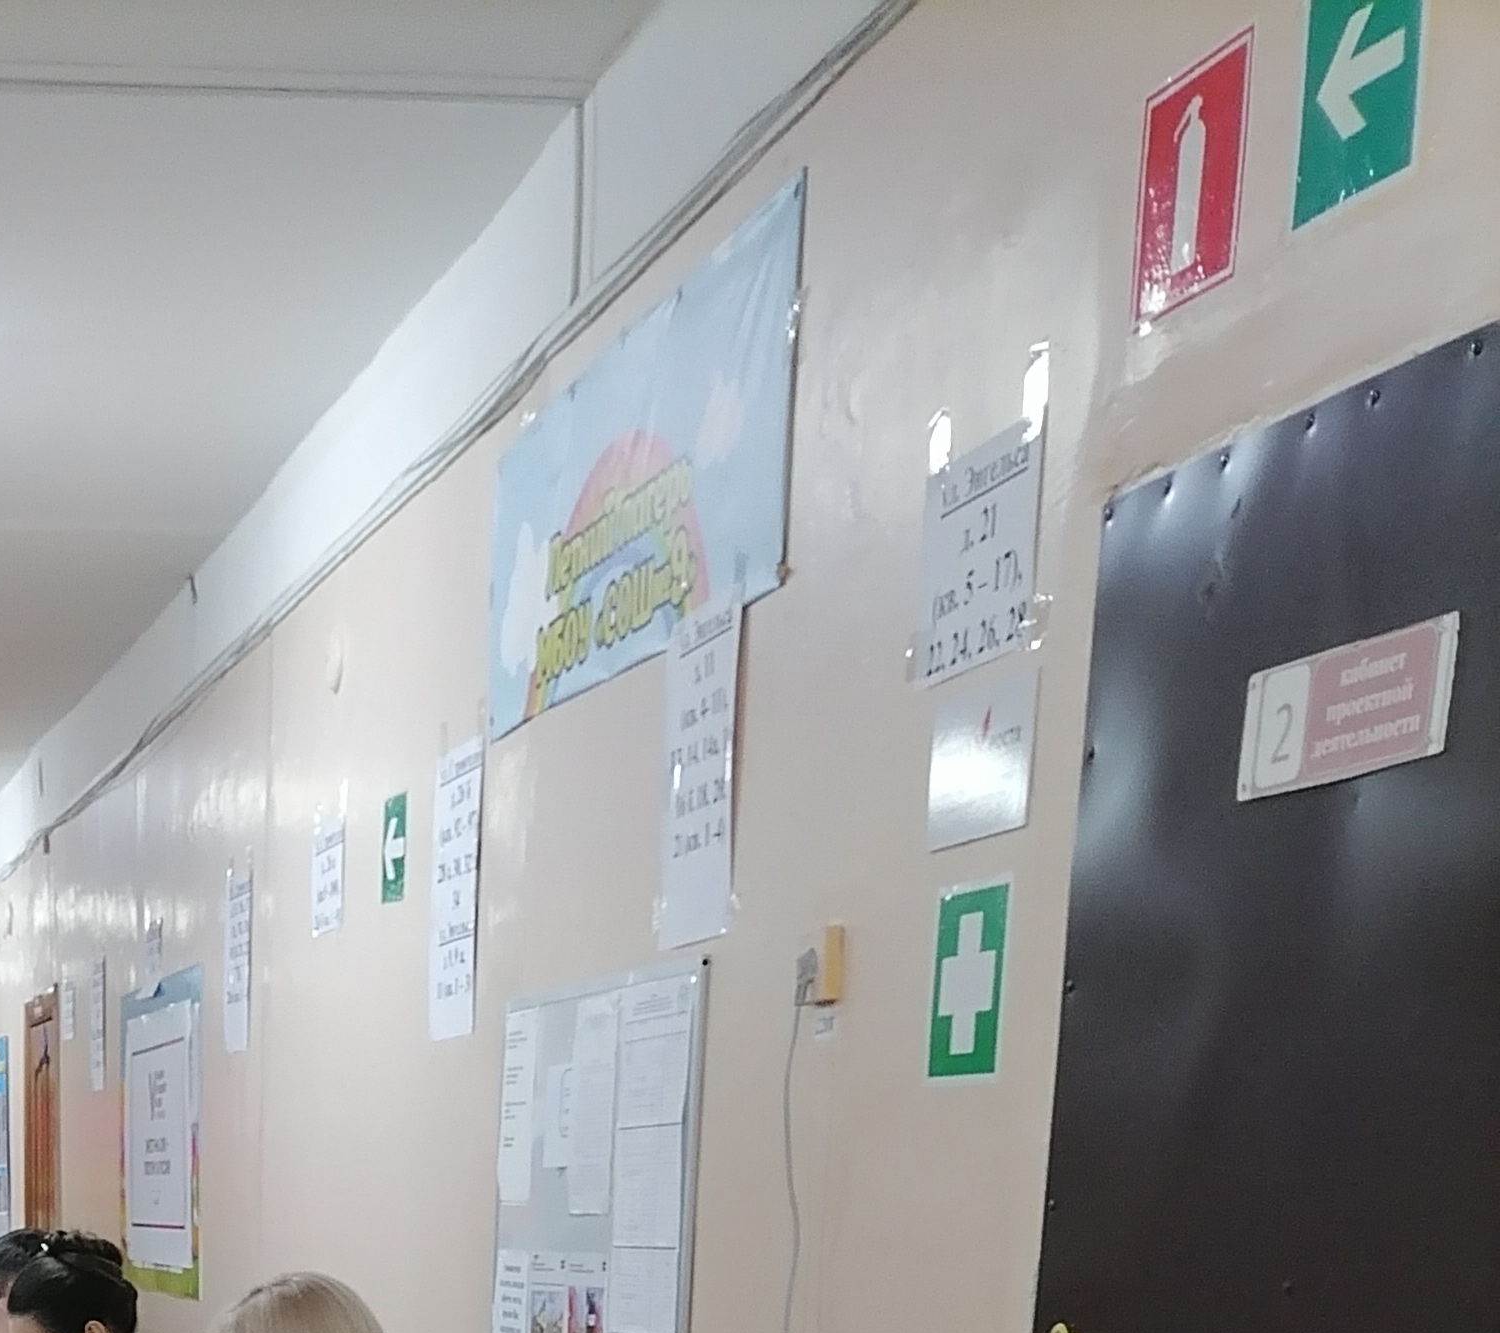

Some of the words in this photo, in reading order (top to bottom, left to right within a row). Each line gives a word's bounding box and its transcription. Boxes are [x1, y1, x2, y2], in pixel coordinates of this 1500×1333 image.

[546, 487, 620, 602] Летний
[619, 455, 693, 552] лагерь
[981, 503, 997, 542] 21
[536, 597, 592, 690] МБОУ
[1341, 652, 1407, 687] кабинет
[1270, 703, 1293, 764] 2
[1310, 713, 1420, 758] деятельности
